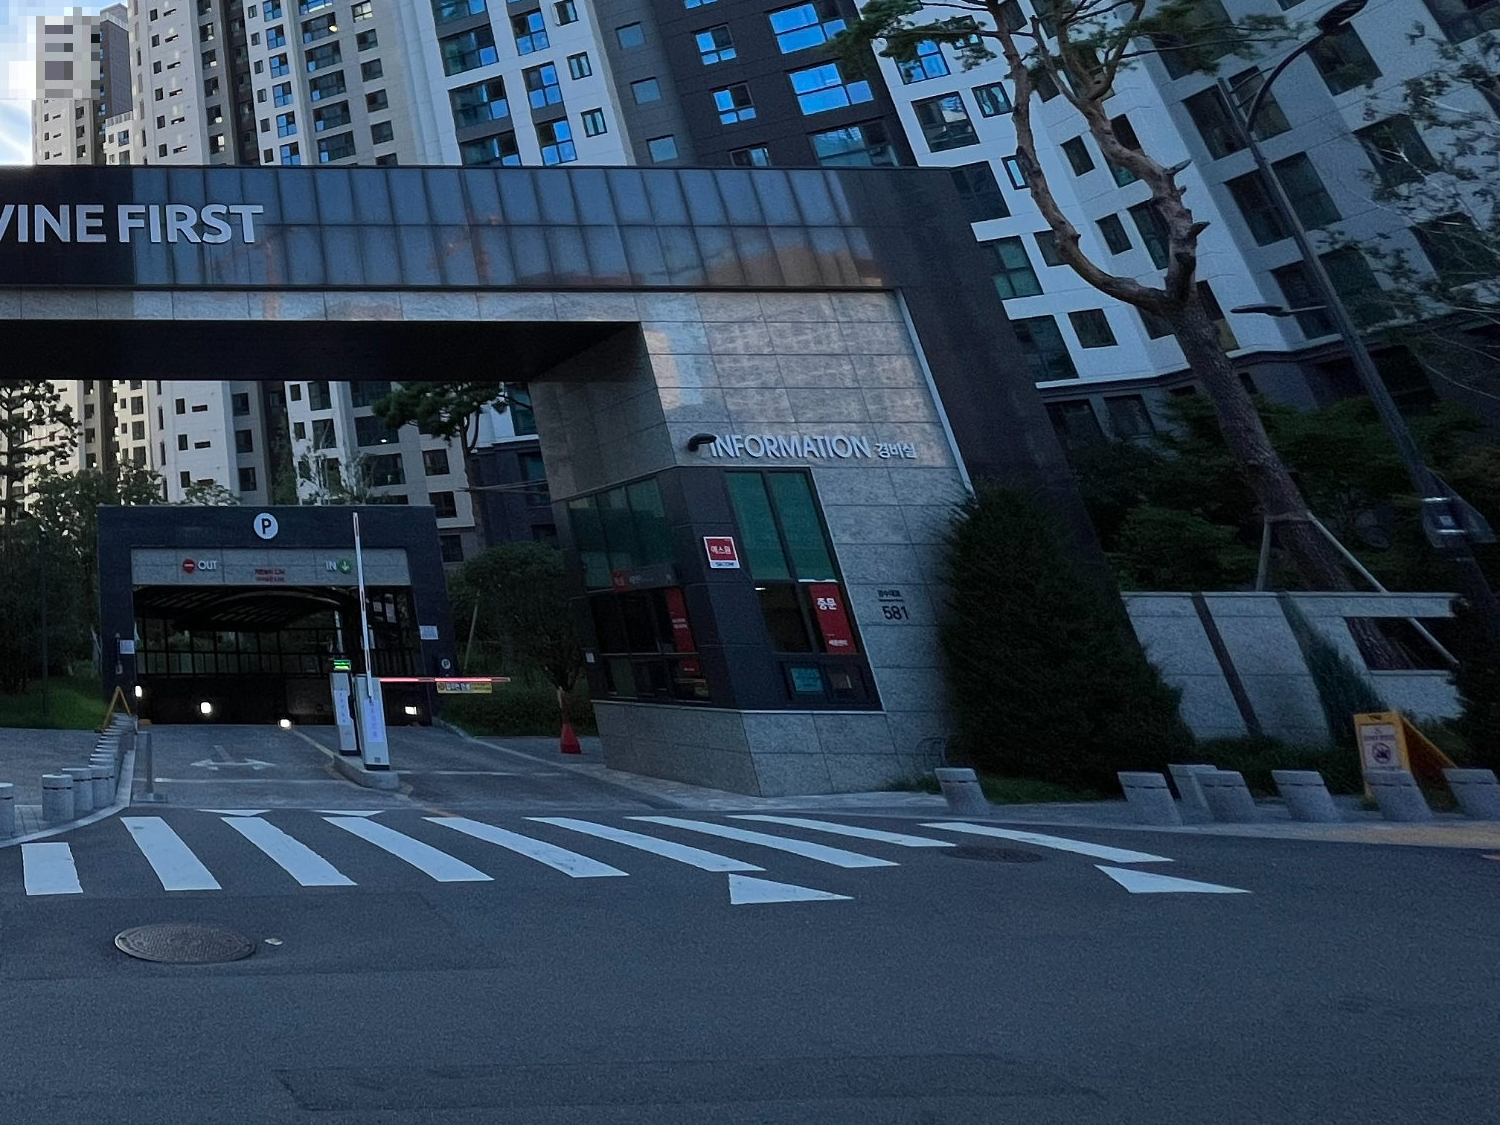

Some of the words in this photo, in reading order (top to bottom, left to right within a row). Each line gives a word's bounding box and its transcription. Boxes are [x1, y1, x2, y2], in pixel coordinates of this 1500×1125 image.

[117, 204, 265, 244] FIRST
[710, 434, 873, 460] INFORMATION
[875, 442, 918, 460] 경비실
[260, 518, 272, 535] P
[197, 560, 218, 571] OUT
[326, 560, 338, 571] IN
[882, 605, 910, 620] 581
